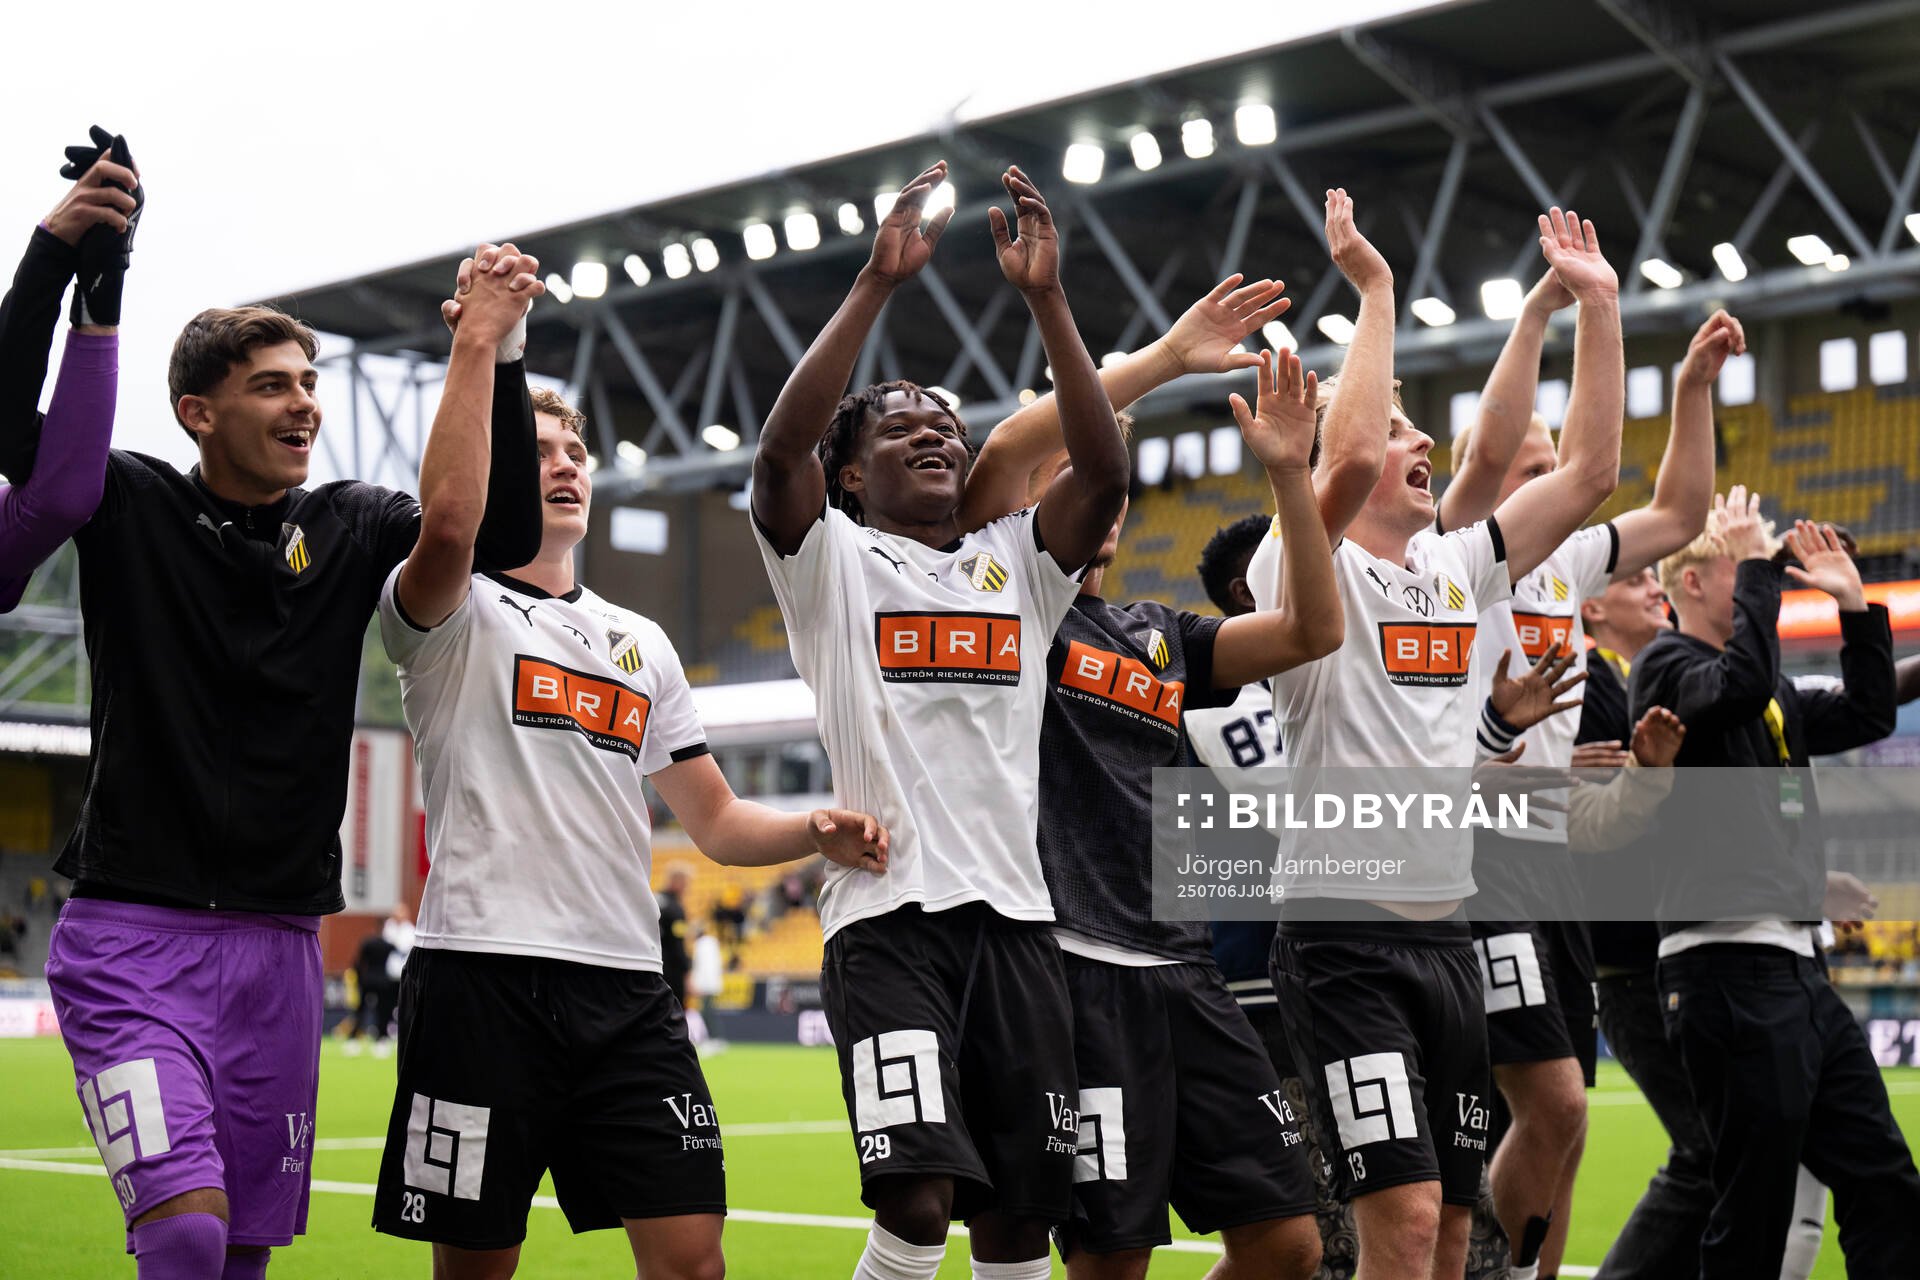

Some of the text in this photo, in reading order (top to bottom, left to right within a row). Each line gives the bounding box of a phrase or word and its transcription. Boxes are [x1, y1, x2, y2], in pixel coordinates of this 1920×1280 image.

[937, 671, 974, 679] RIEMER
[1057, 686, 1108, 708] BILLSTRÖM
[1111, 704, 1140, 720] RIEMER
[516, 714, 572, 727] BILLSTRÖM
[860, 1134, 891, 1165] 29
[1347, 1151, 1367, 1182] 13
[117, 1173, 136, 1209] 30
[401, 1191, 426, 1223] 28
